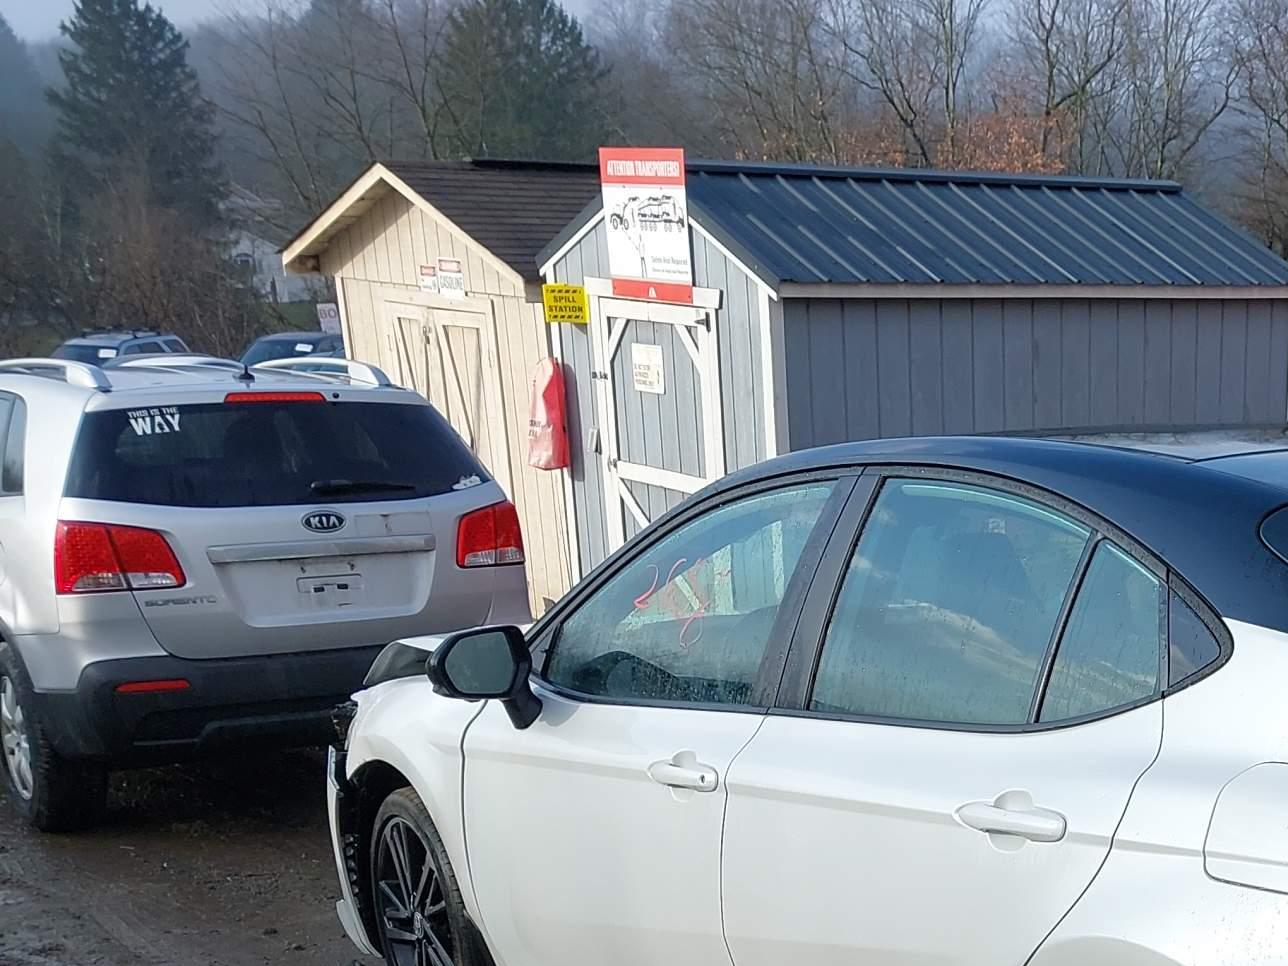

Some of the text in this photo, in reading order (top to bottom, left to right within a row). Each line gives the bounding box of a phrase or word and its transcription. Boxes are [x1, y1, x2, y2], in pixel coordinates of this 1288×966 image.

[607, 160, 635, 176] ATTENTION
[553, 295, 577, 303] SPILL
[549, 305, 583, 313] STATION
[127, 410, 149, 418] THIS
[129, 414, 180, 436] WAY
[310, 516, 340, 528] KIA
